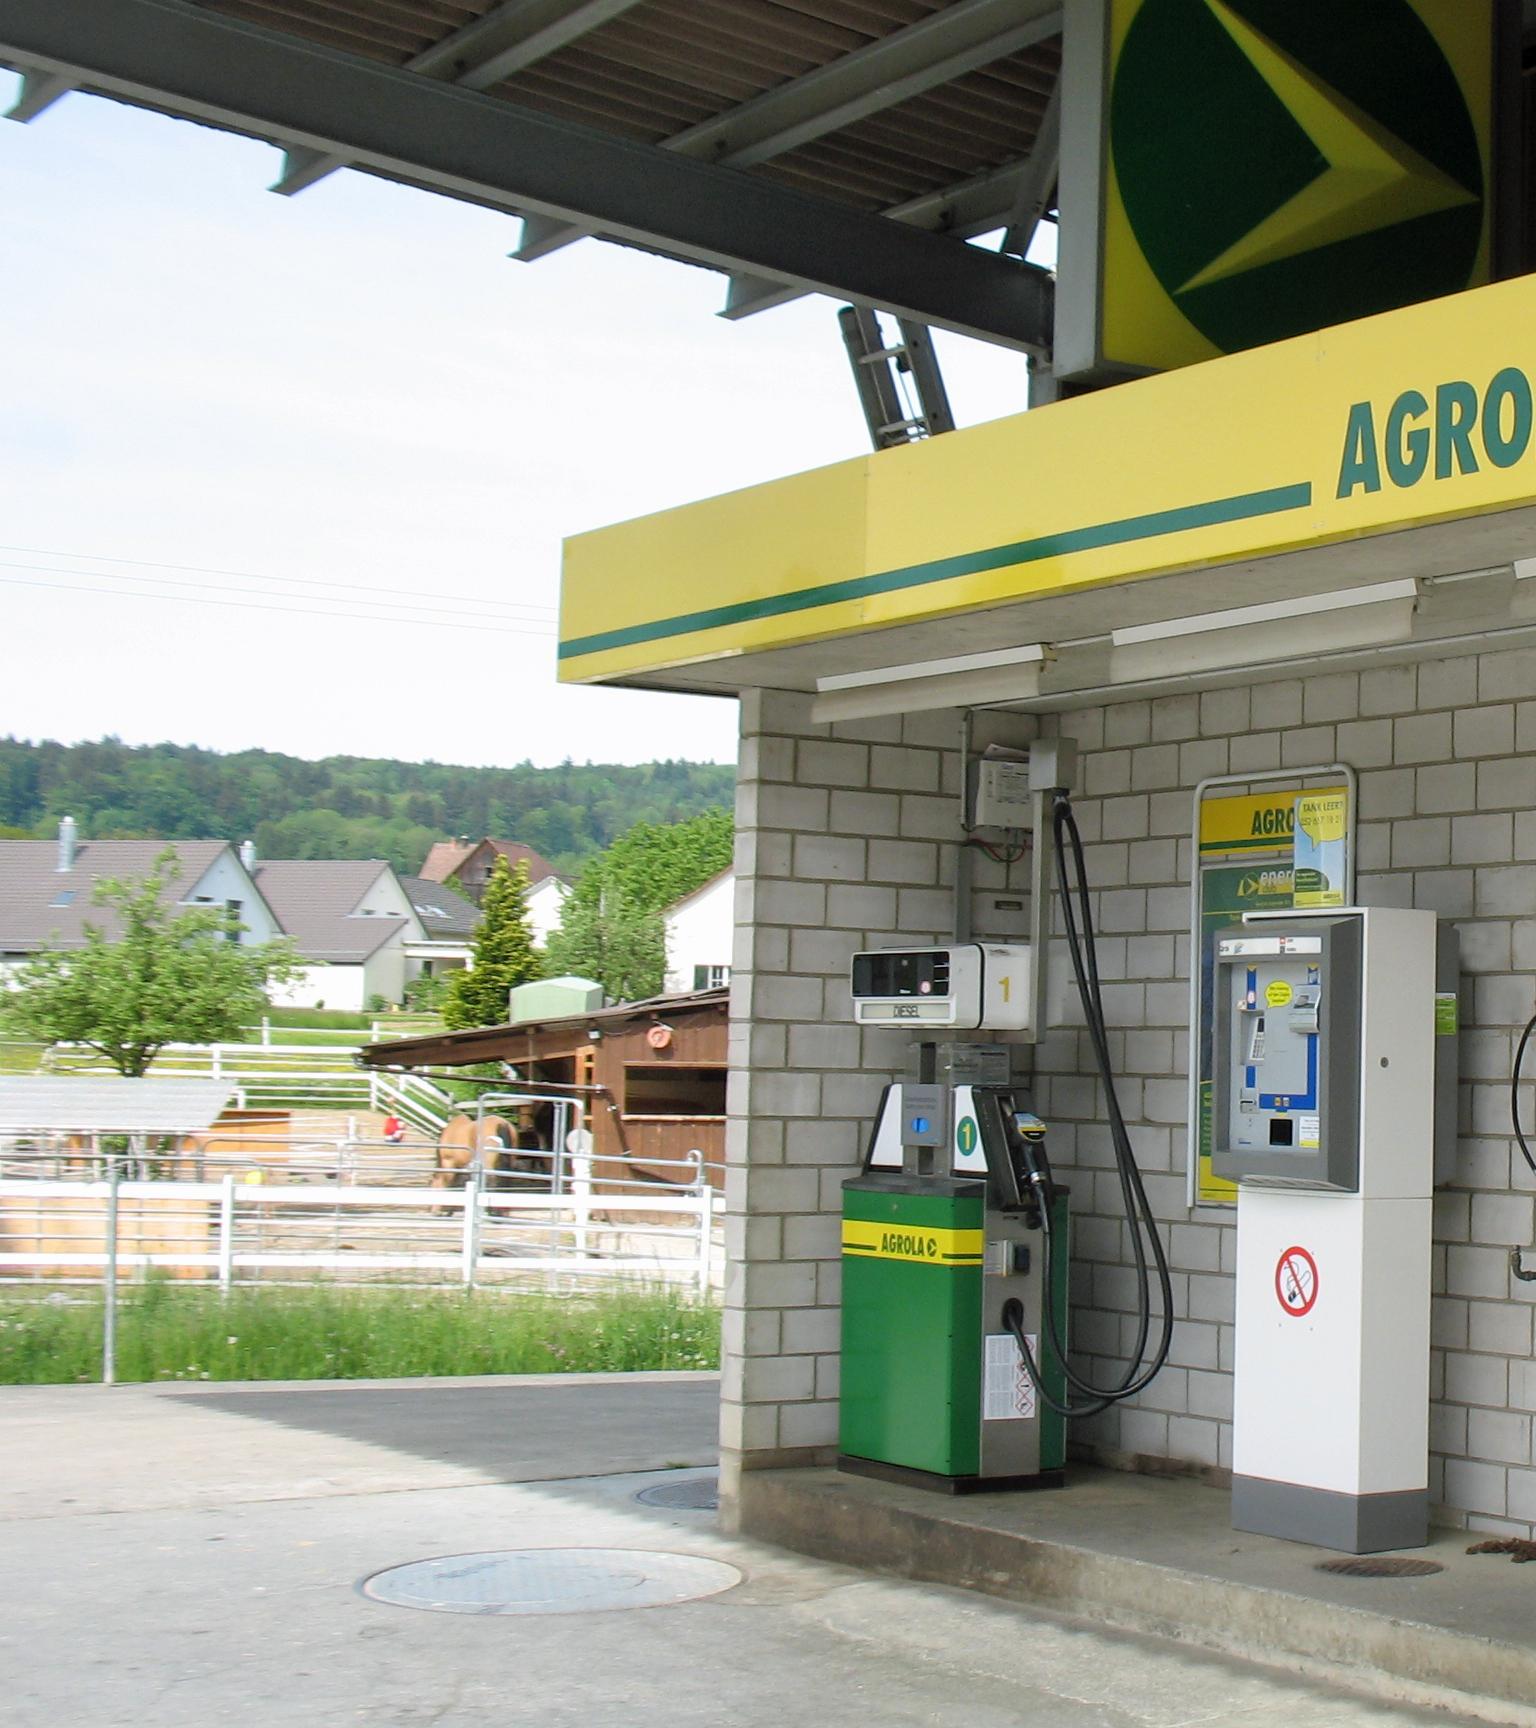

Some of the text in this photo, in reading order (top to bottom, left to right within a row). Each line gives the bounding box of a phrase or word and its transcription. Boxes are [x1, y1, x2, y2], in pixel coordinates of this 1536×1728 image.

[1251, 807, 1294, 836] AGRO
[999, 976, 1010, 1002] 1
[962, 1124, 971, 1150] 1
[881, 1232, 926, 1257] AGROLA
